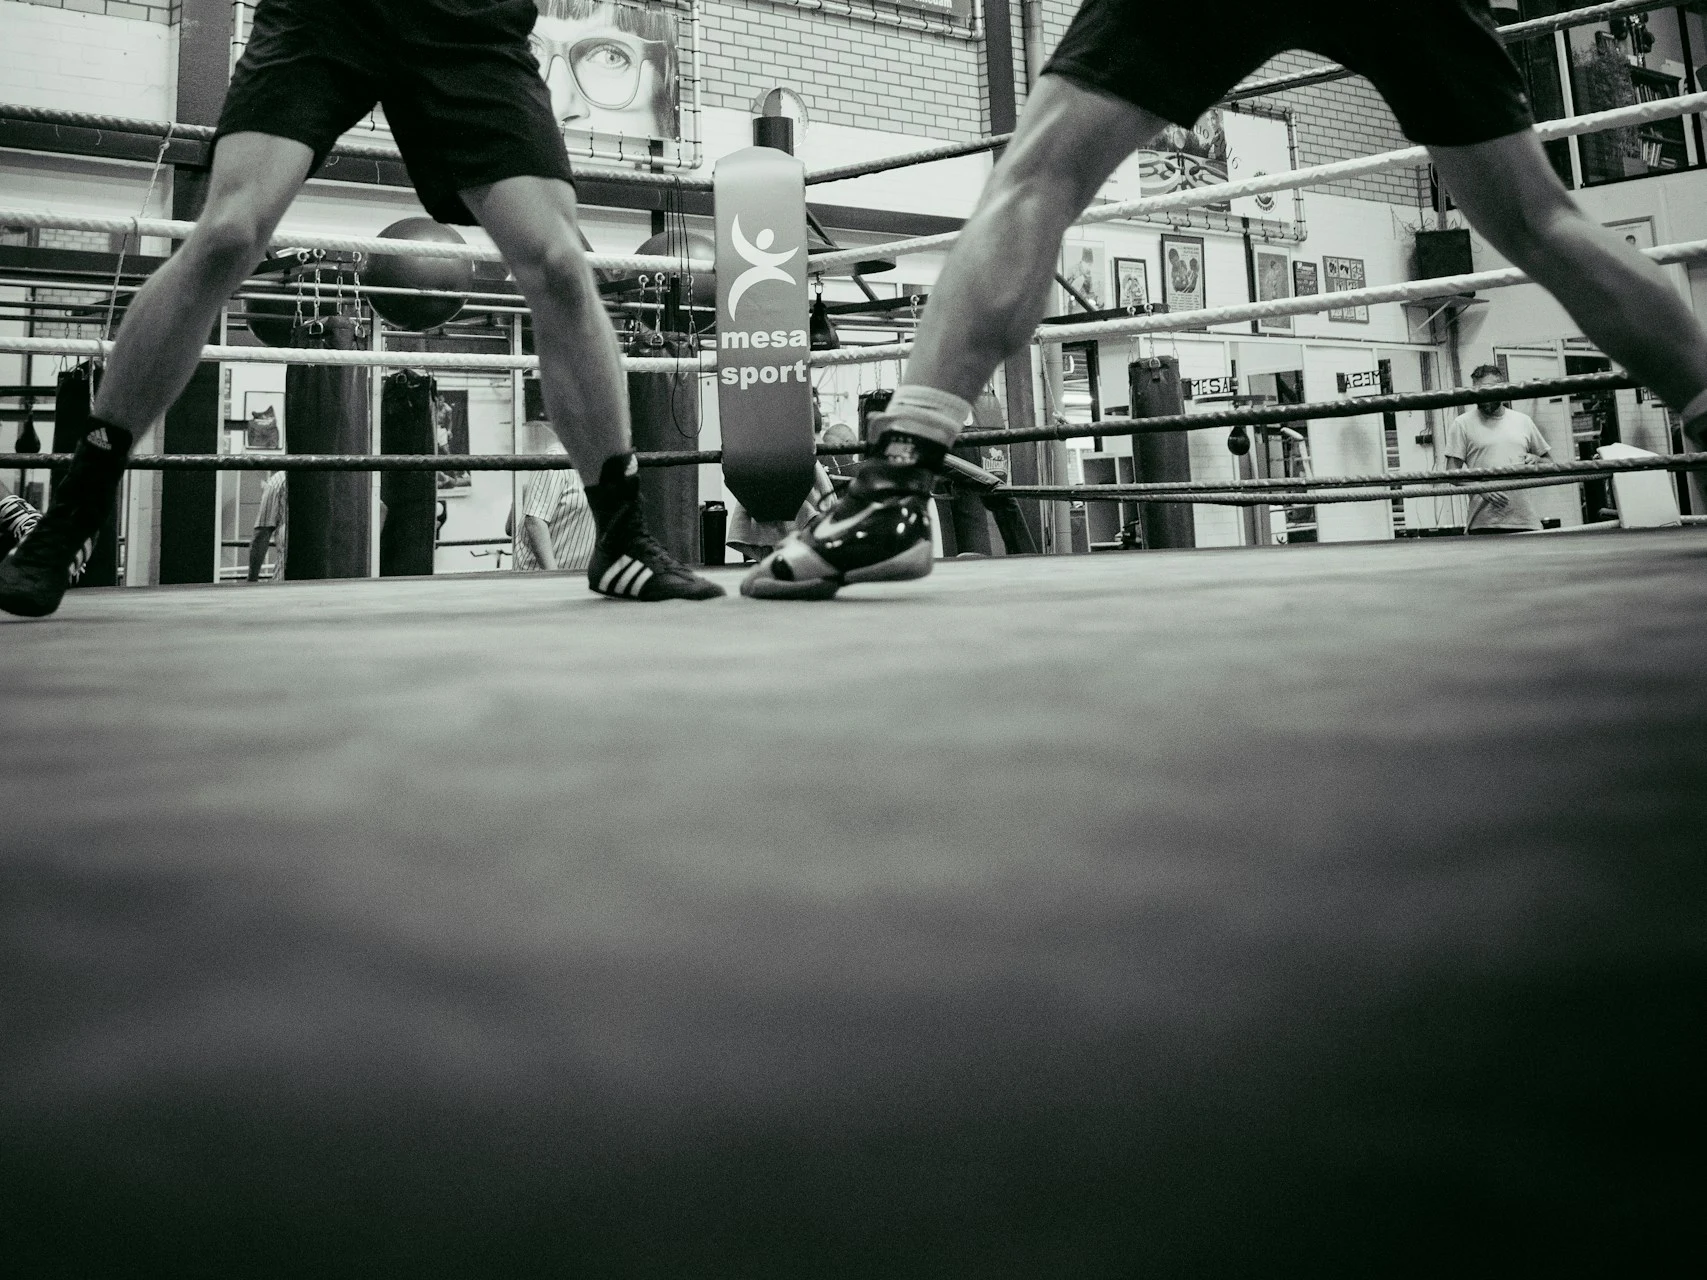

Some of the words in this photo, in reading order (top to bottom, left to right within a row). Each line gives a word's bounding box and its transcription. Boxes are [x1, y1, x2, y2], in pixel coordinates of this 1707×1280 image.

[721, 329, 807, 349] mesa
[721, 360, 807, 390] sport
[1190, 377, 1230, 396] MESA
